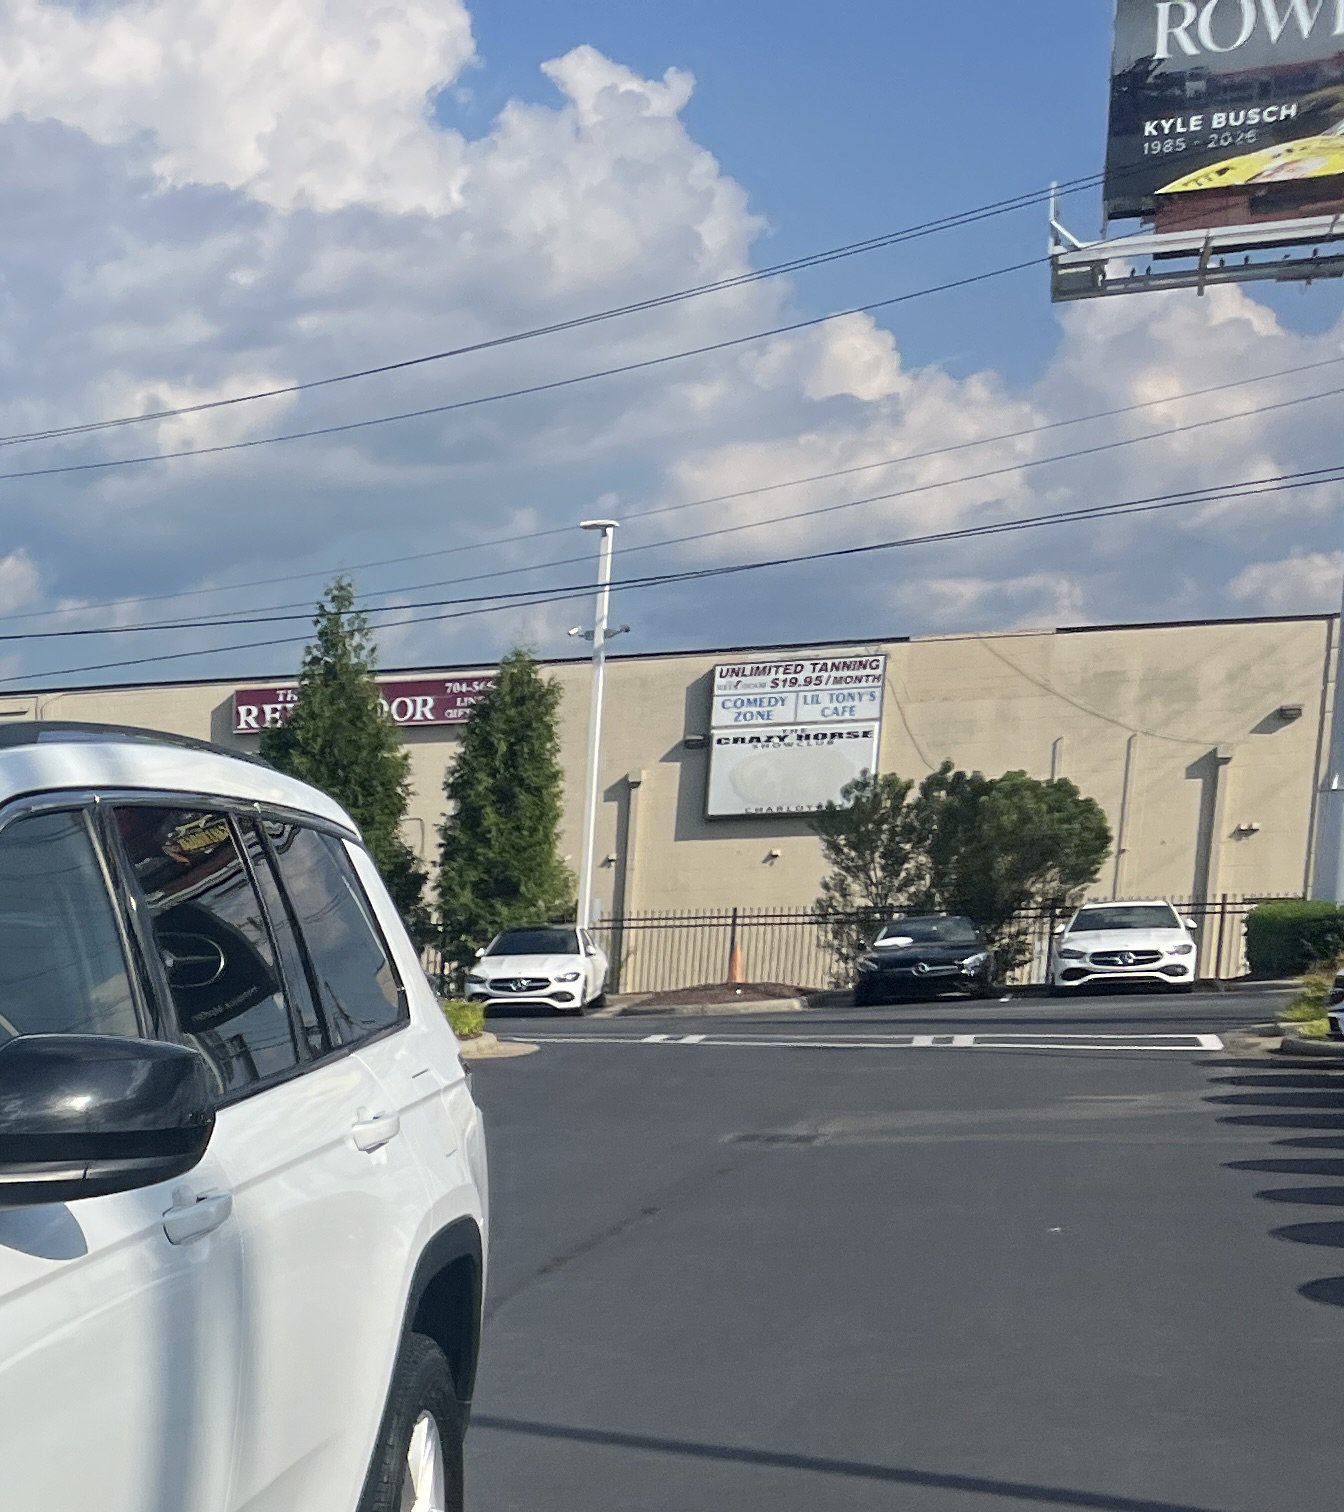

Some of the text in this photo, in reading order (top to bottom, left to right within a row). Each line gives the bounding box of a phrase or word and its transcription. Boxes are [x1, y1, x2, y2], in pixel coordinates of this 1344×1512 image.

[1153, 0, 1344, 60] ROW
[1143, 103, 1298, 137] KYLE BUSCH
[1143, 138, 1187, 155] 1985
[719, 658, 880, 679] UNLIMITED TANNING
[721, 696, 788, 710] COMEDY
[803, 694, 824, 706] LIL
[733, 710, 775, 722] ZONE
[820, 705, 857, 718] CAFE
[716, 730, 875, 746] CRAZY HORSE
